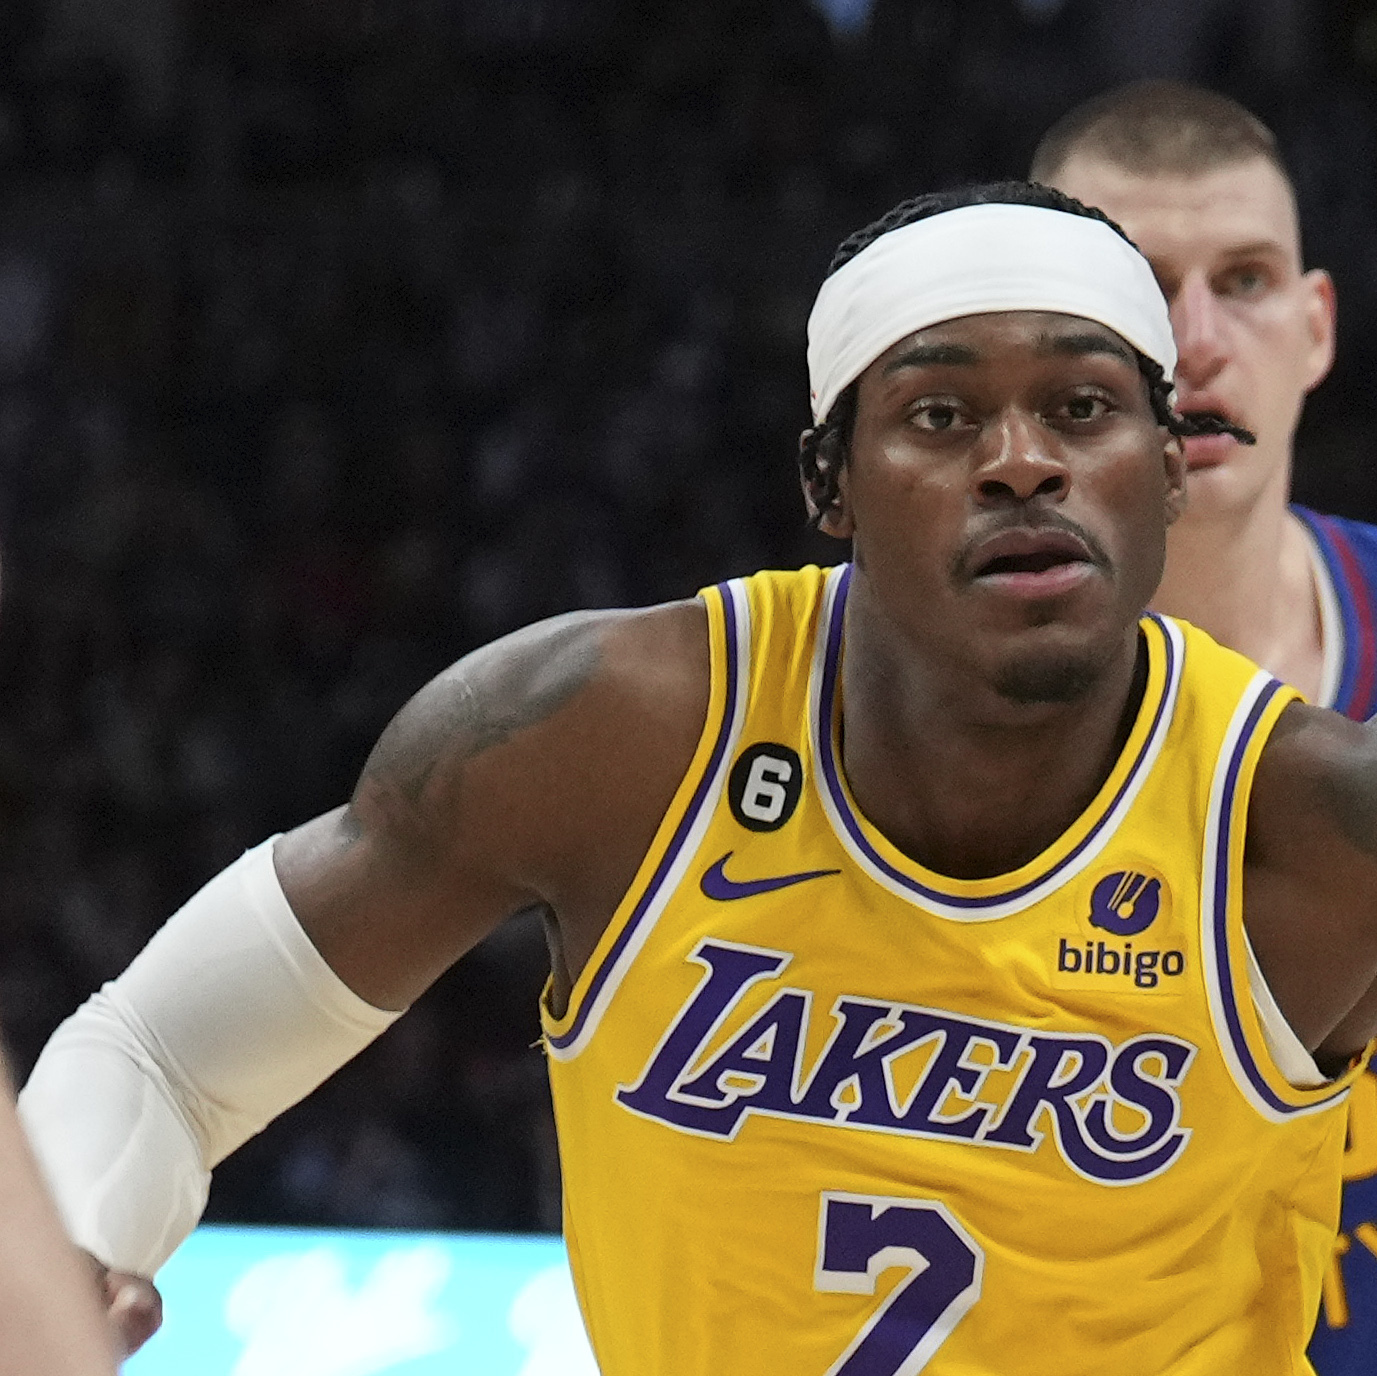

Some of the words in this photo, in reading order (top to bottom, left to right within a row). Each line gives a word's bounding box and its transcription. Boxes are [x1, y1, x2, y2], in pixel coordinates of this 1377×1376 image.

[740, 754, 793, 823] 6
[1058, 938, 1184, 988] bibigo
[614, 936, 1198, 1188] LAKERS
